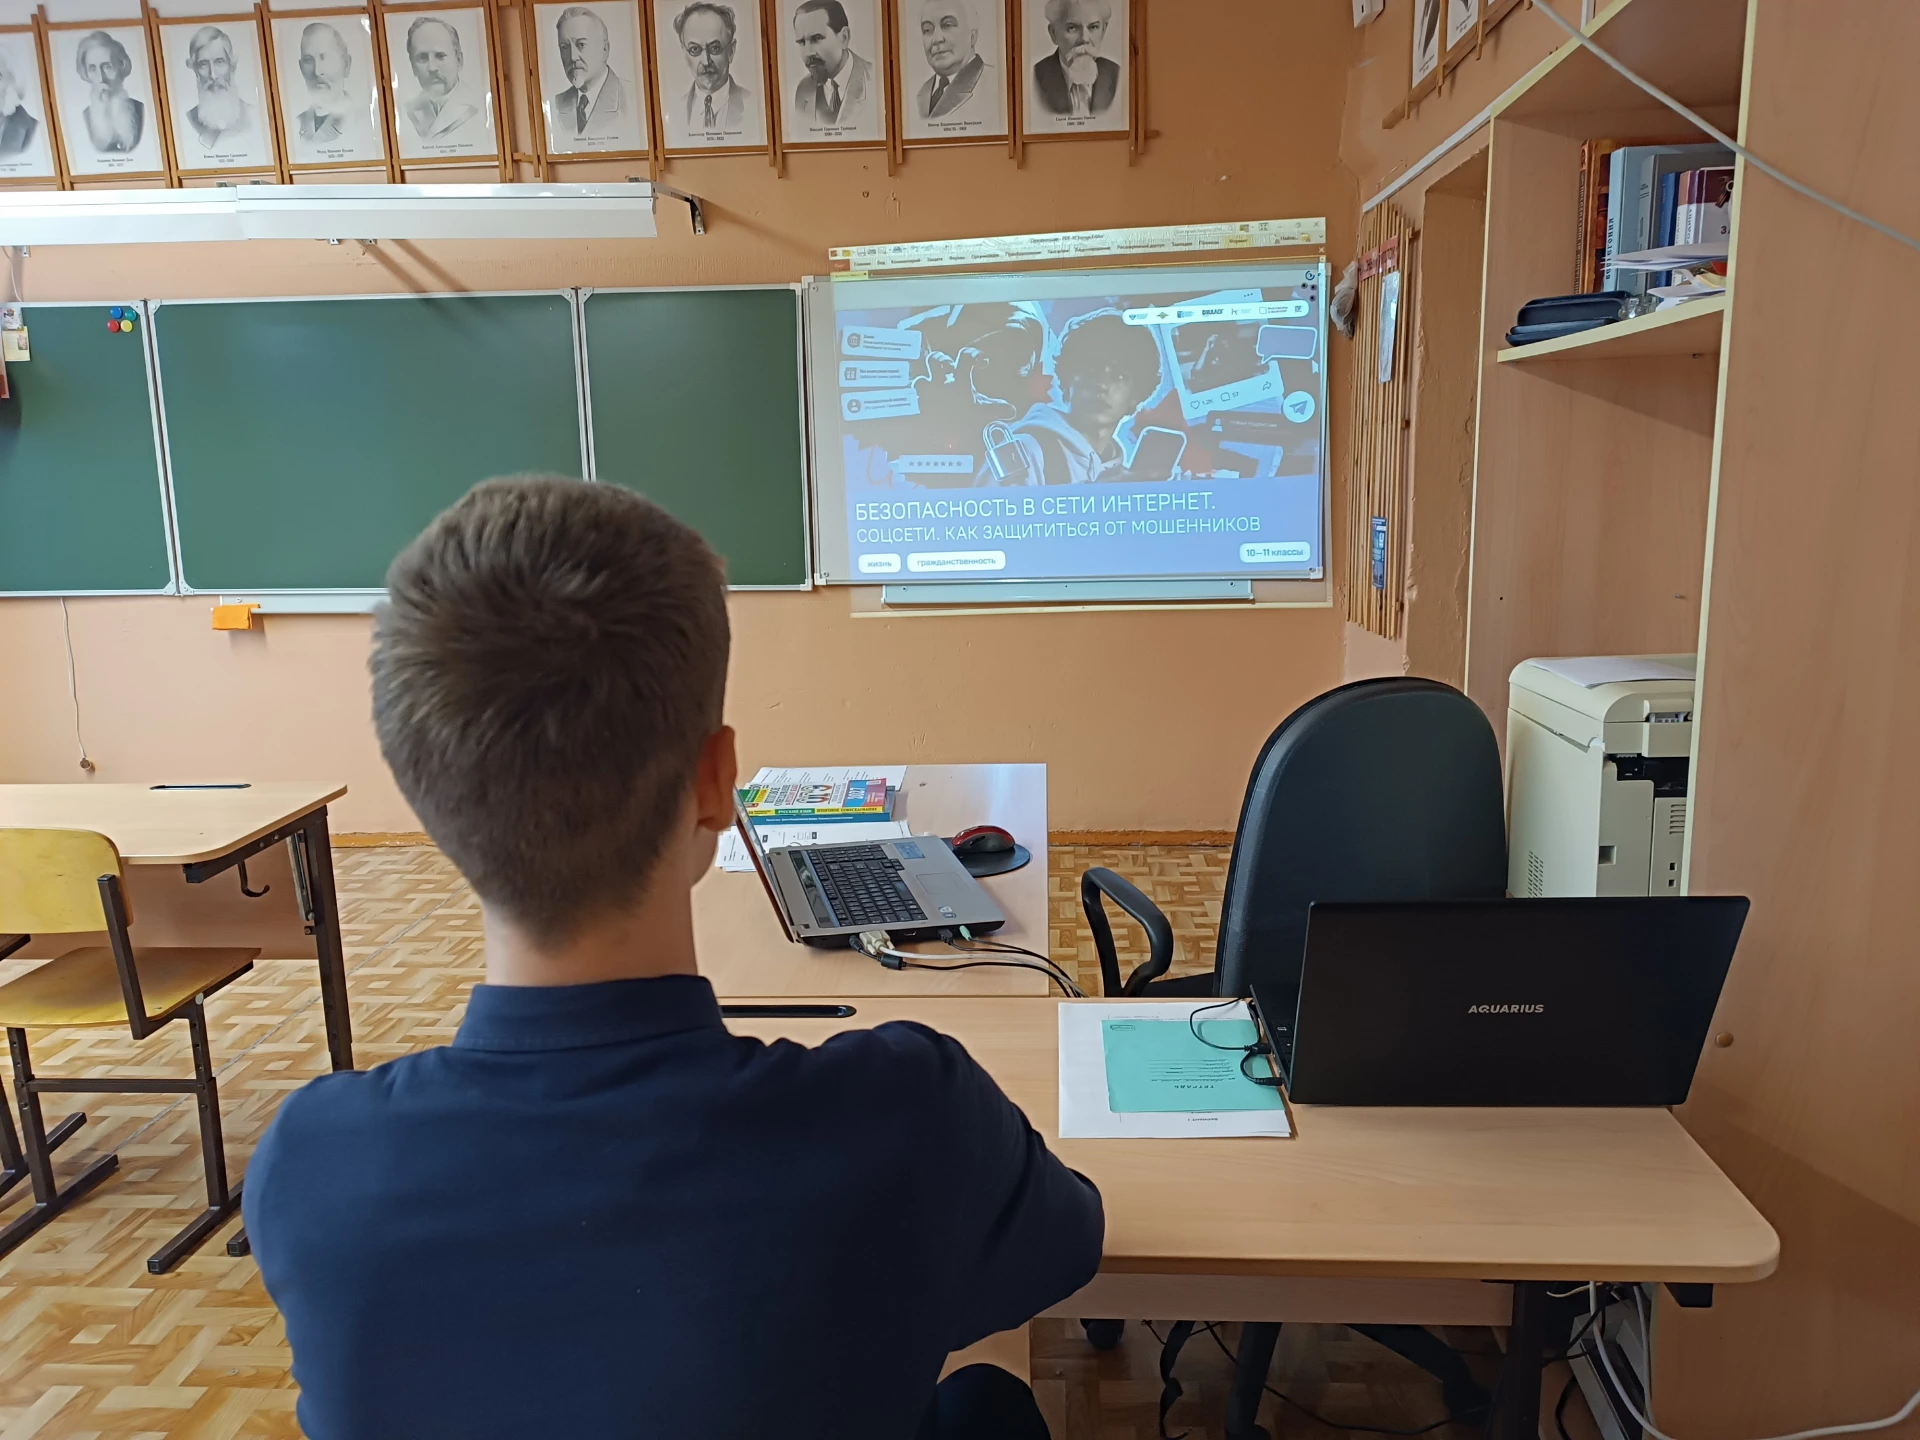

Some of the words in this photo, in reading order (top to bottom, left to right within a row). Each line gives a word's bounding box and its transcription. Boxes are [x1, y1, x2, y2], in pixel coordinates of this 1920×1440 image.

[855, 498, 1018, 521] БЕЗОПАСНОСТЬ
[1023, 498, 1035, 516] В
[1041, 496, 1095, 515] СЕТИ
[1102, 491, 1216, 513] ИНТЕРНЕТ.
[856, 526, 941, 544] СОЦСЕТИ.
[945, 525, 979, 541] КАК
[983, 522, 1100, 541] ЗАЩИТИТЬСЯ
[1104, 520, 1127, 536] ОТ
[1131, 516, 1261, 535] МОШЕННИКОВ
[1271, 548, 1304, 557] классы
[866, 560, 892, 568] жизнь
[917, 557, 996, 568] гражданственность
[1468, 1004, 1544, 1013] AQUARIUS
